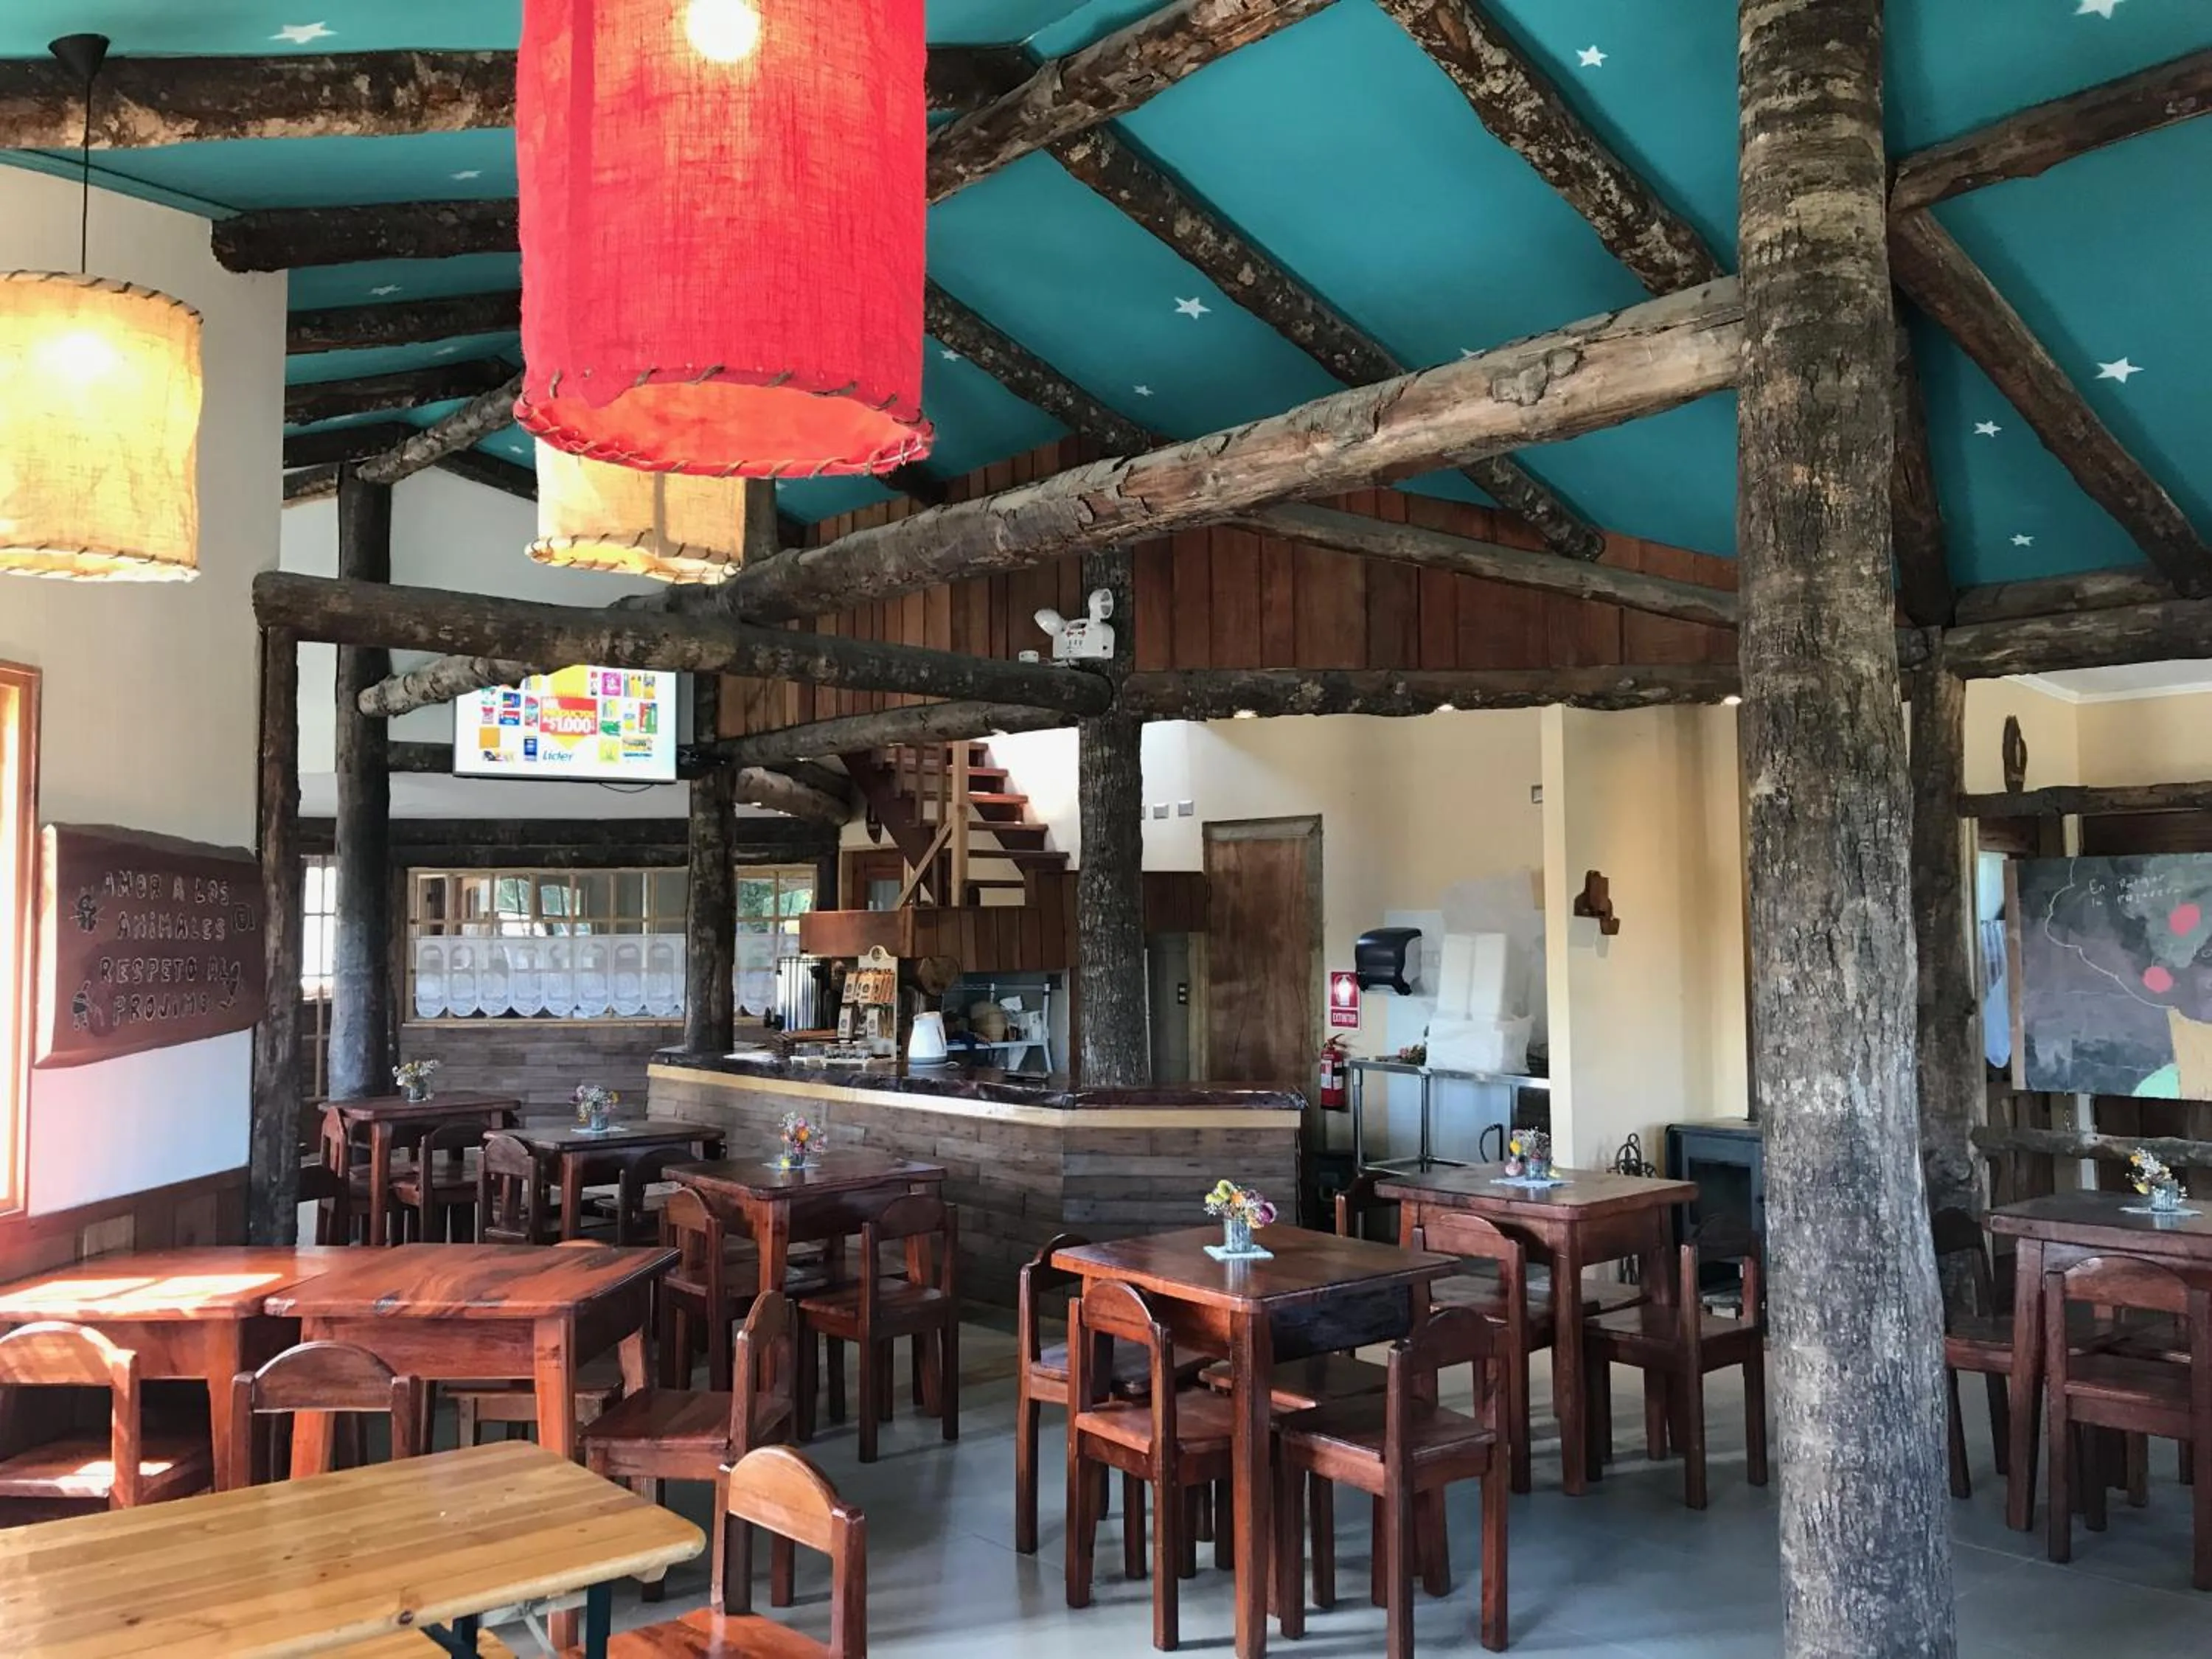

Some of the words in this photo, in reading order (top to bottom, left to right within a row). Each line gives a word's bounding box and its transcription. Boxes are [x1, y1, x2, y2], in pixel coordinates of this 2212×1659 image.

[104, 870, 161, 900] AMOR
[173, 876, 184, 901] A
[100, 956, 197, 983] RESPETO
